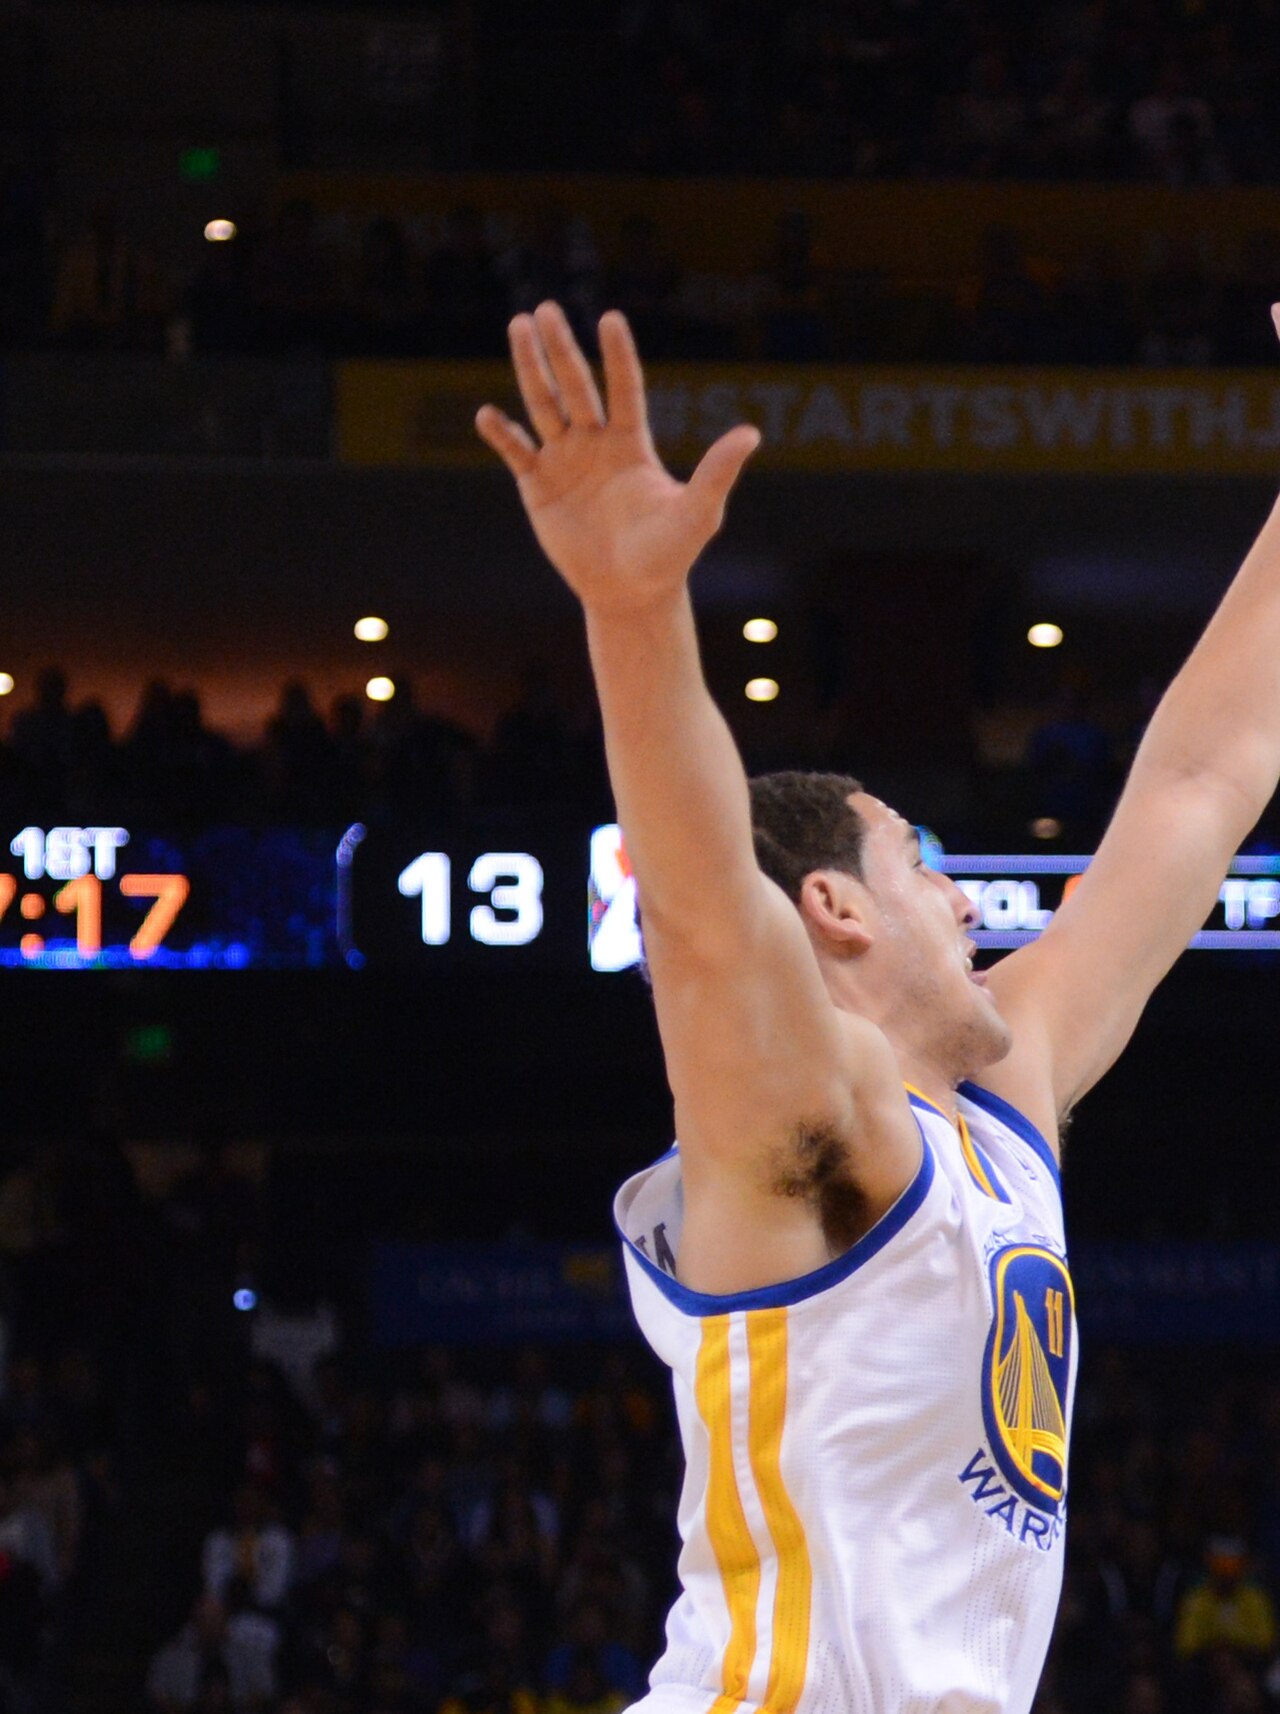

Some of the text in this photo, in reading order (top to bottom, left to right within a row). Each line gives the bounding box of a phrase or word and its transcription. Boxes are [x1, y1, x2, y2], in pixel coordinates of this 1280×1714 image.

[0, 873, 190, 959] :17
[399, 852, 544, 945] 13
[1045, 1288, 1064, 1358] 11
[958, 1448, 1064, 1551] WAR
